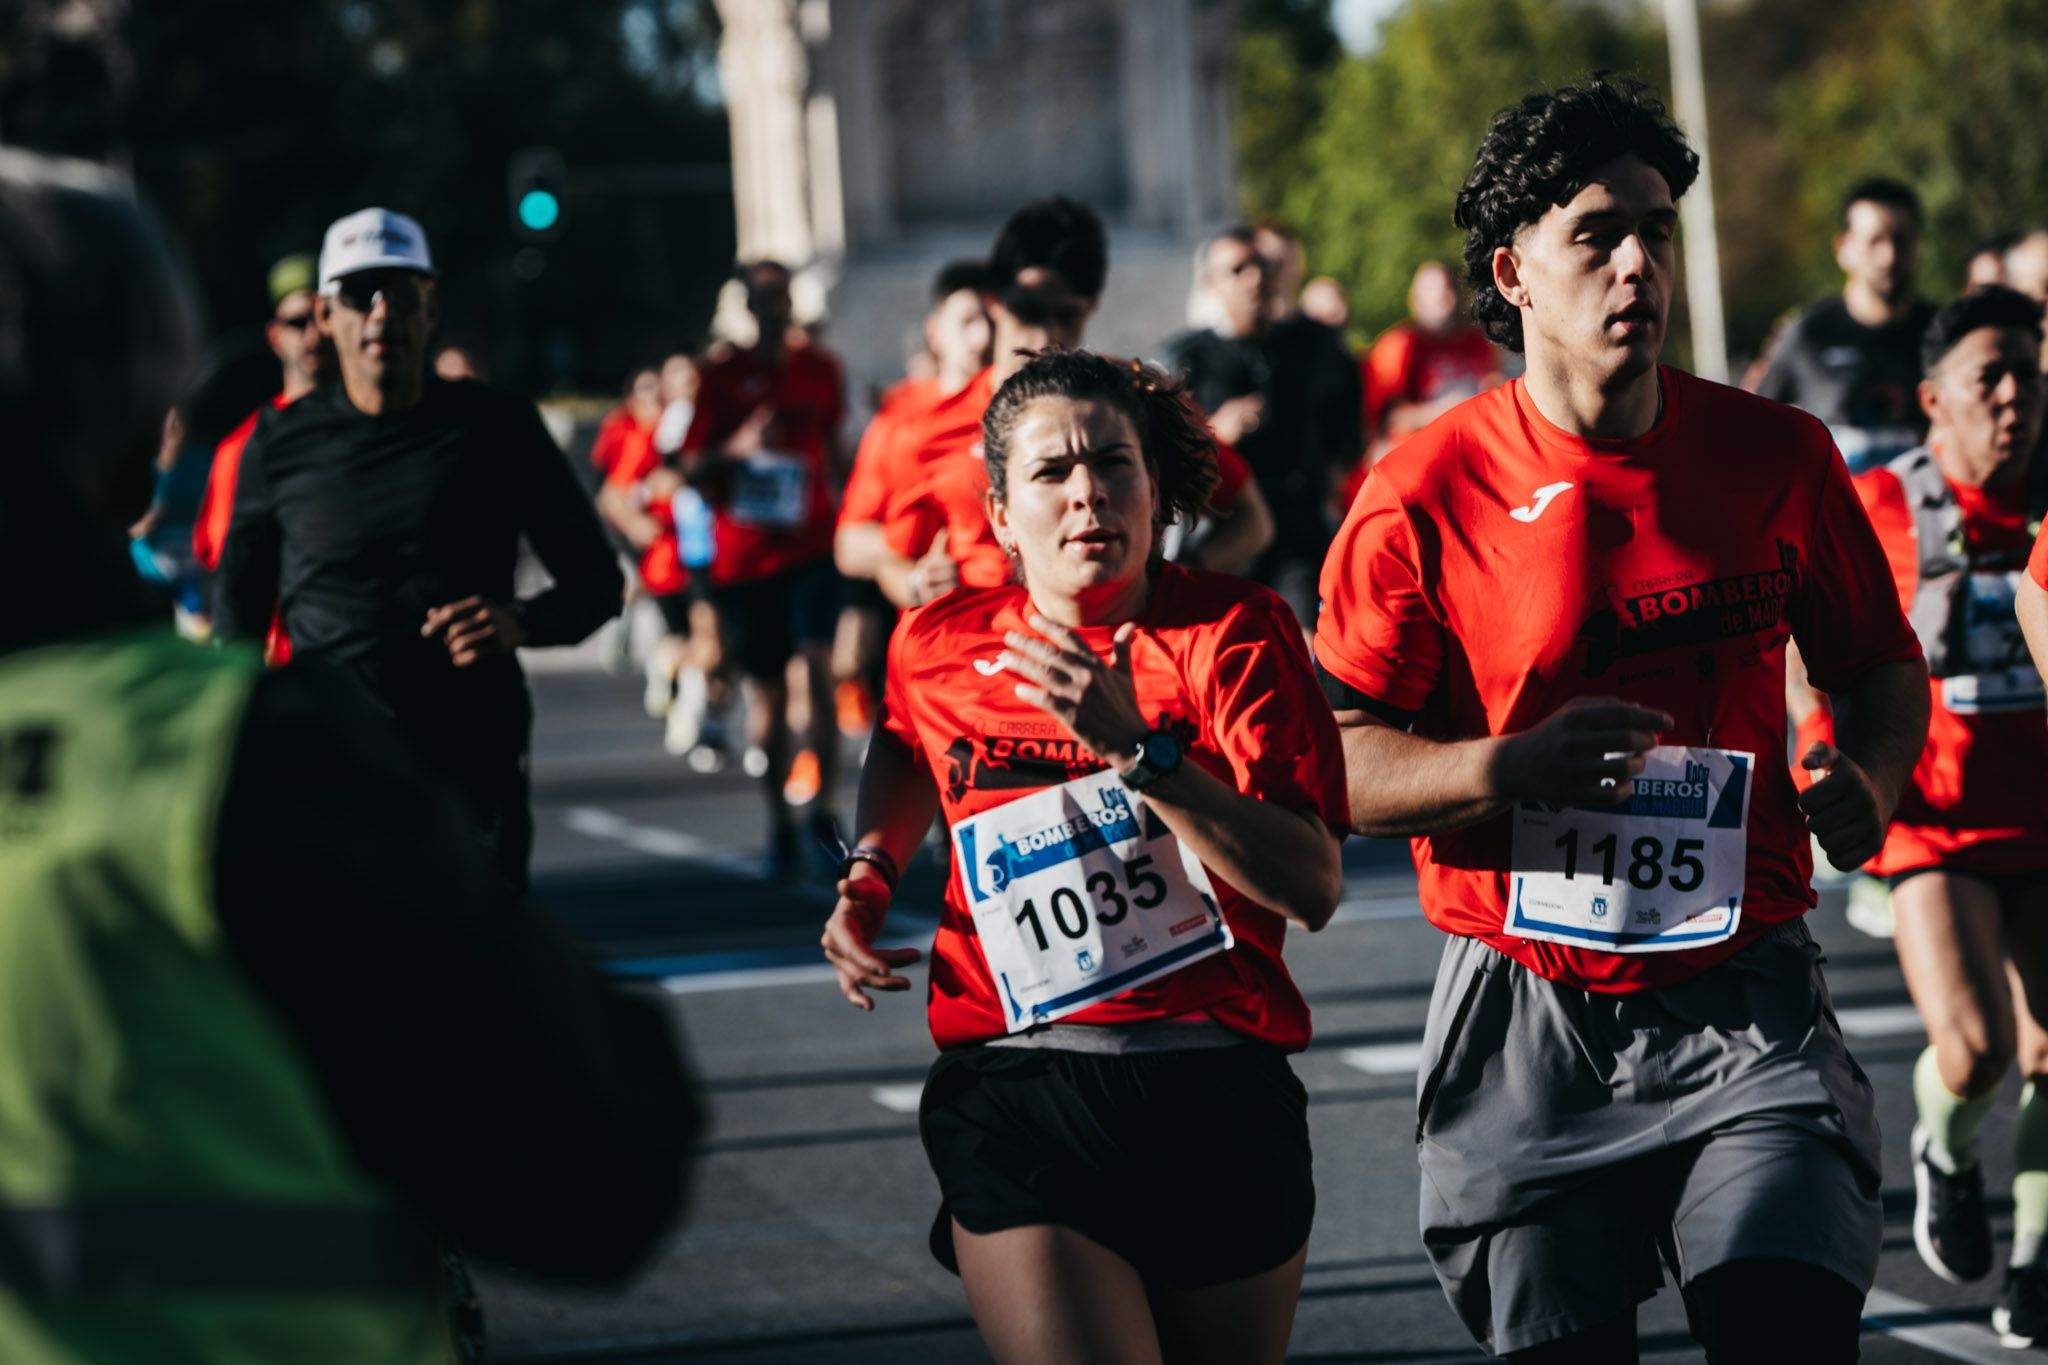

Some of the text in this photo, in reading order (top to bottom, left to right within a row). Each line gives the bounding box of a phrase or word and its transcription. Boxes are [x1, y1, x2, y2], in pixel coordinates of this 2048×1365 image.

[998, 721, 1057, 736] CARRERA
[1015, 803, 1130, 856] BOMBEROS
[1556, 828, 1705, 891] 1185
[1014, 856, 1168, 951] 1035
